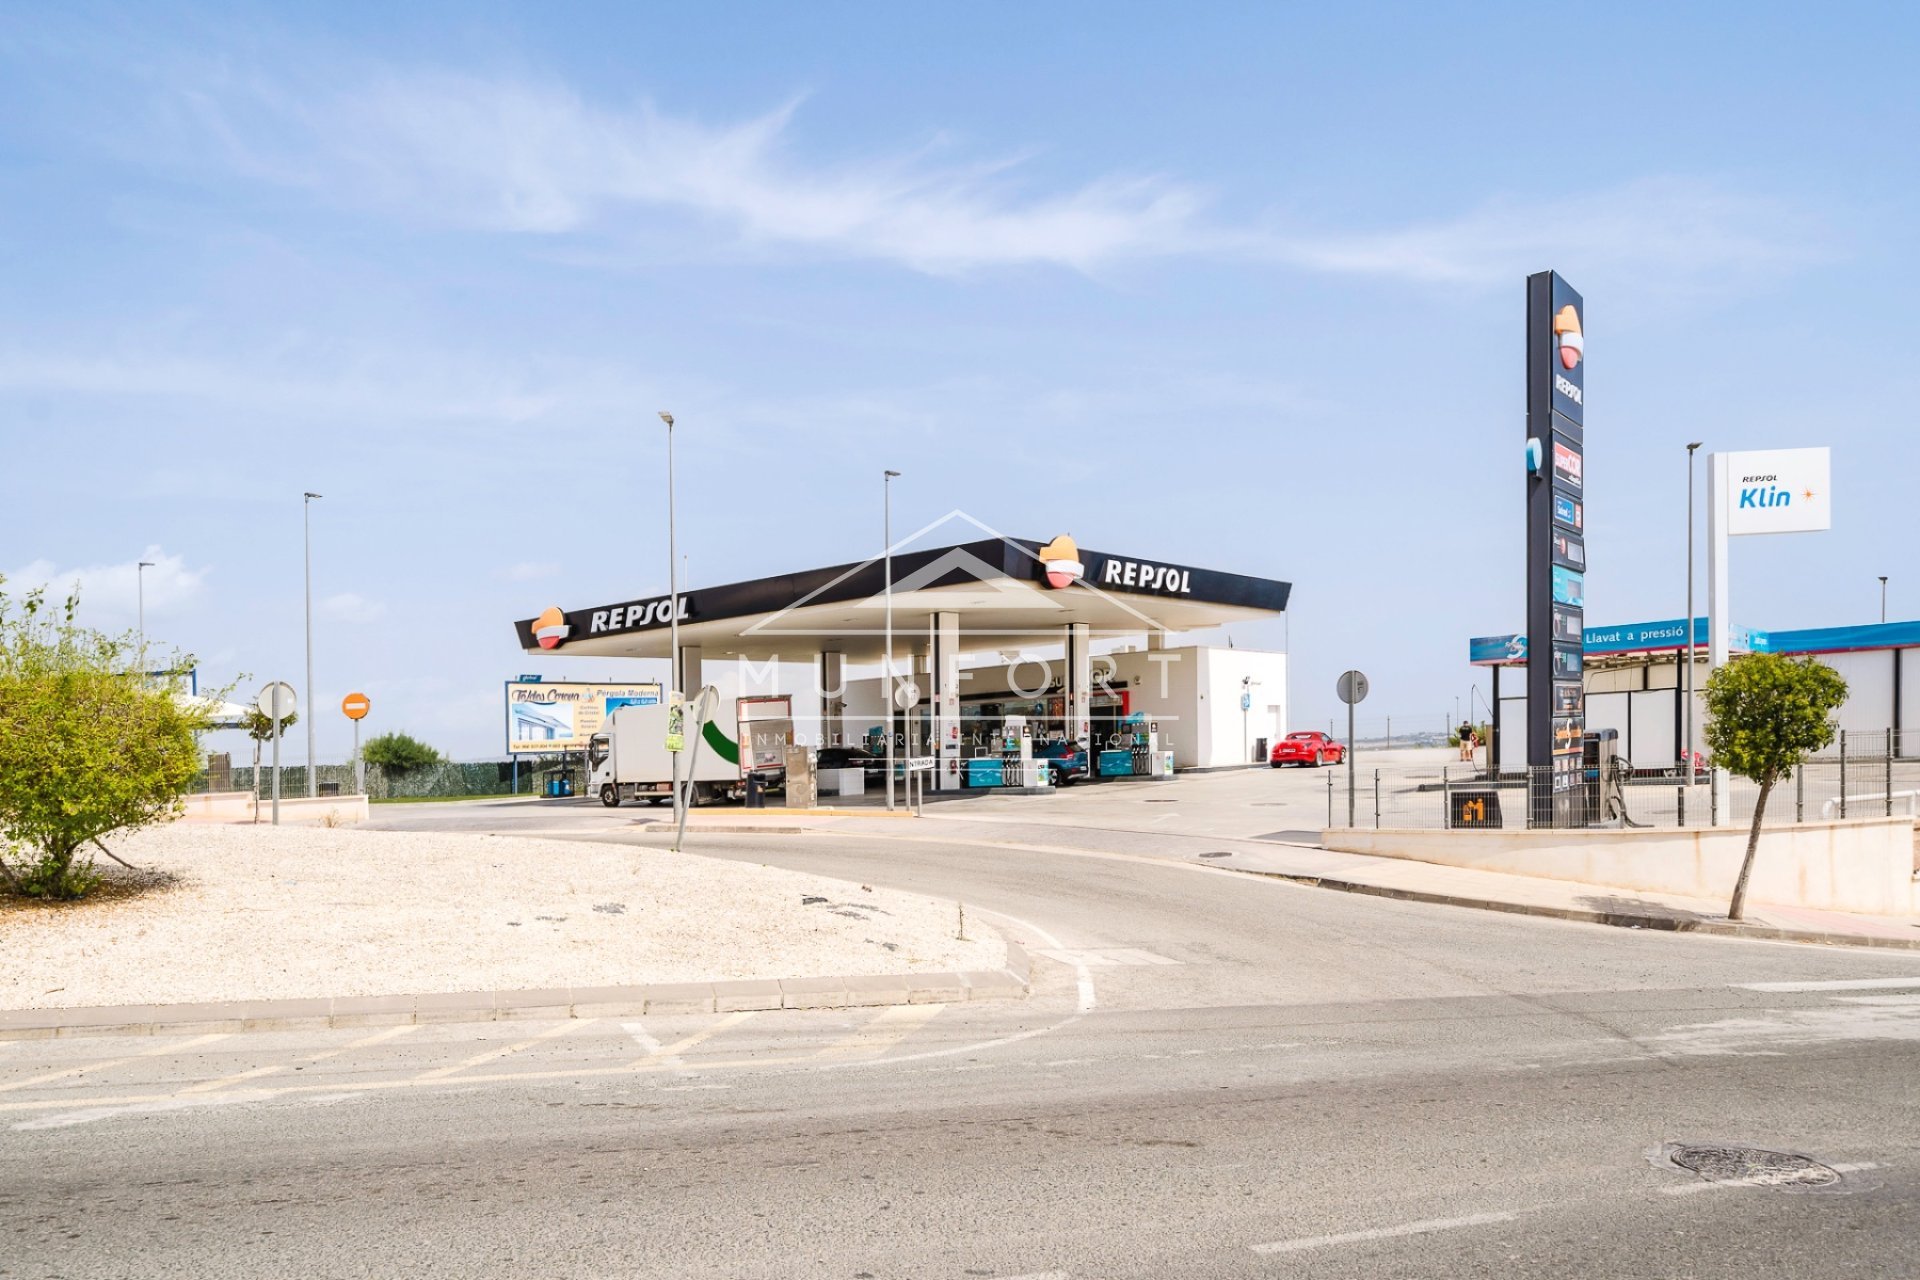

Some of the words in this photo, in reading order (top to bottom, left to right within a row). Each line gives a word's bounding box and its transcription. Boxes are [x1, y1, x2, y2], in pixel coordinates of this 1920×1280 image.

[1740, 485, 1790, 508] Klin
[1105, 559, 1190, 593] REPSOL
[590, 597, 688, 633] REPSOL
[1586, 632, 1620, 643] Llavat
[1627, 632, 1634, 640] a
[1641, 626, 1683, 641] pressió
[909, 759, 933, 767] NTRADA
